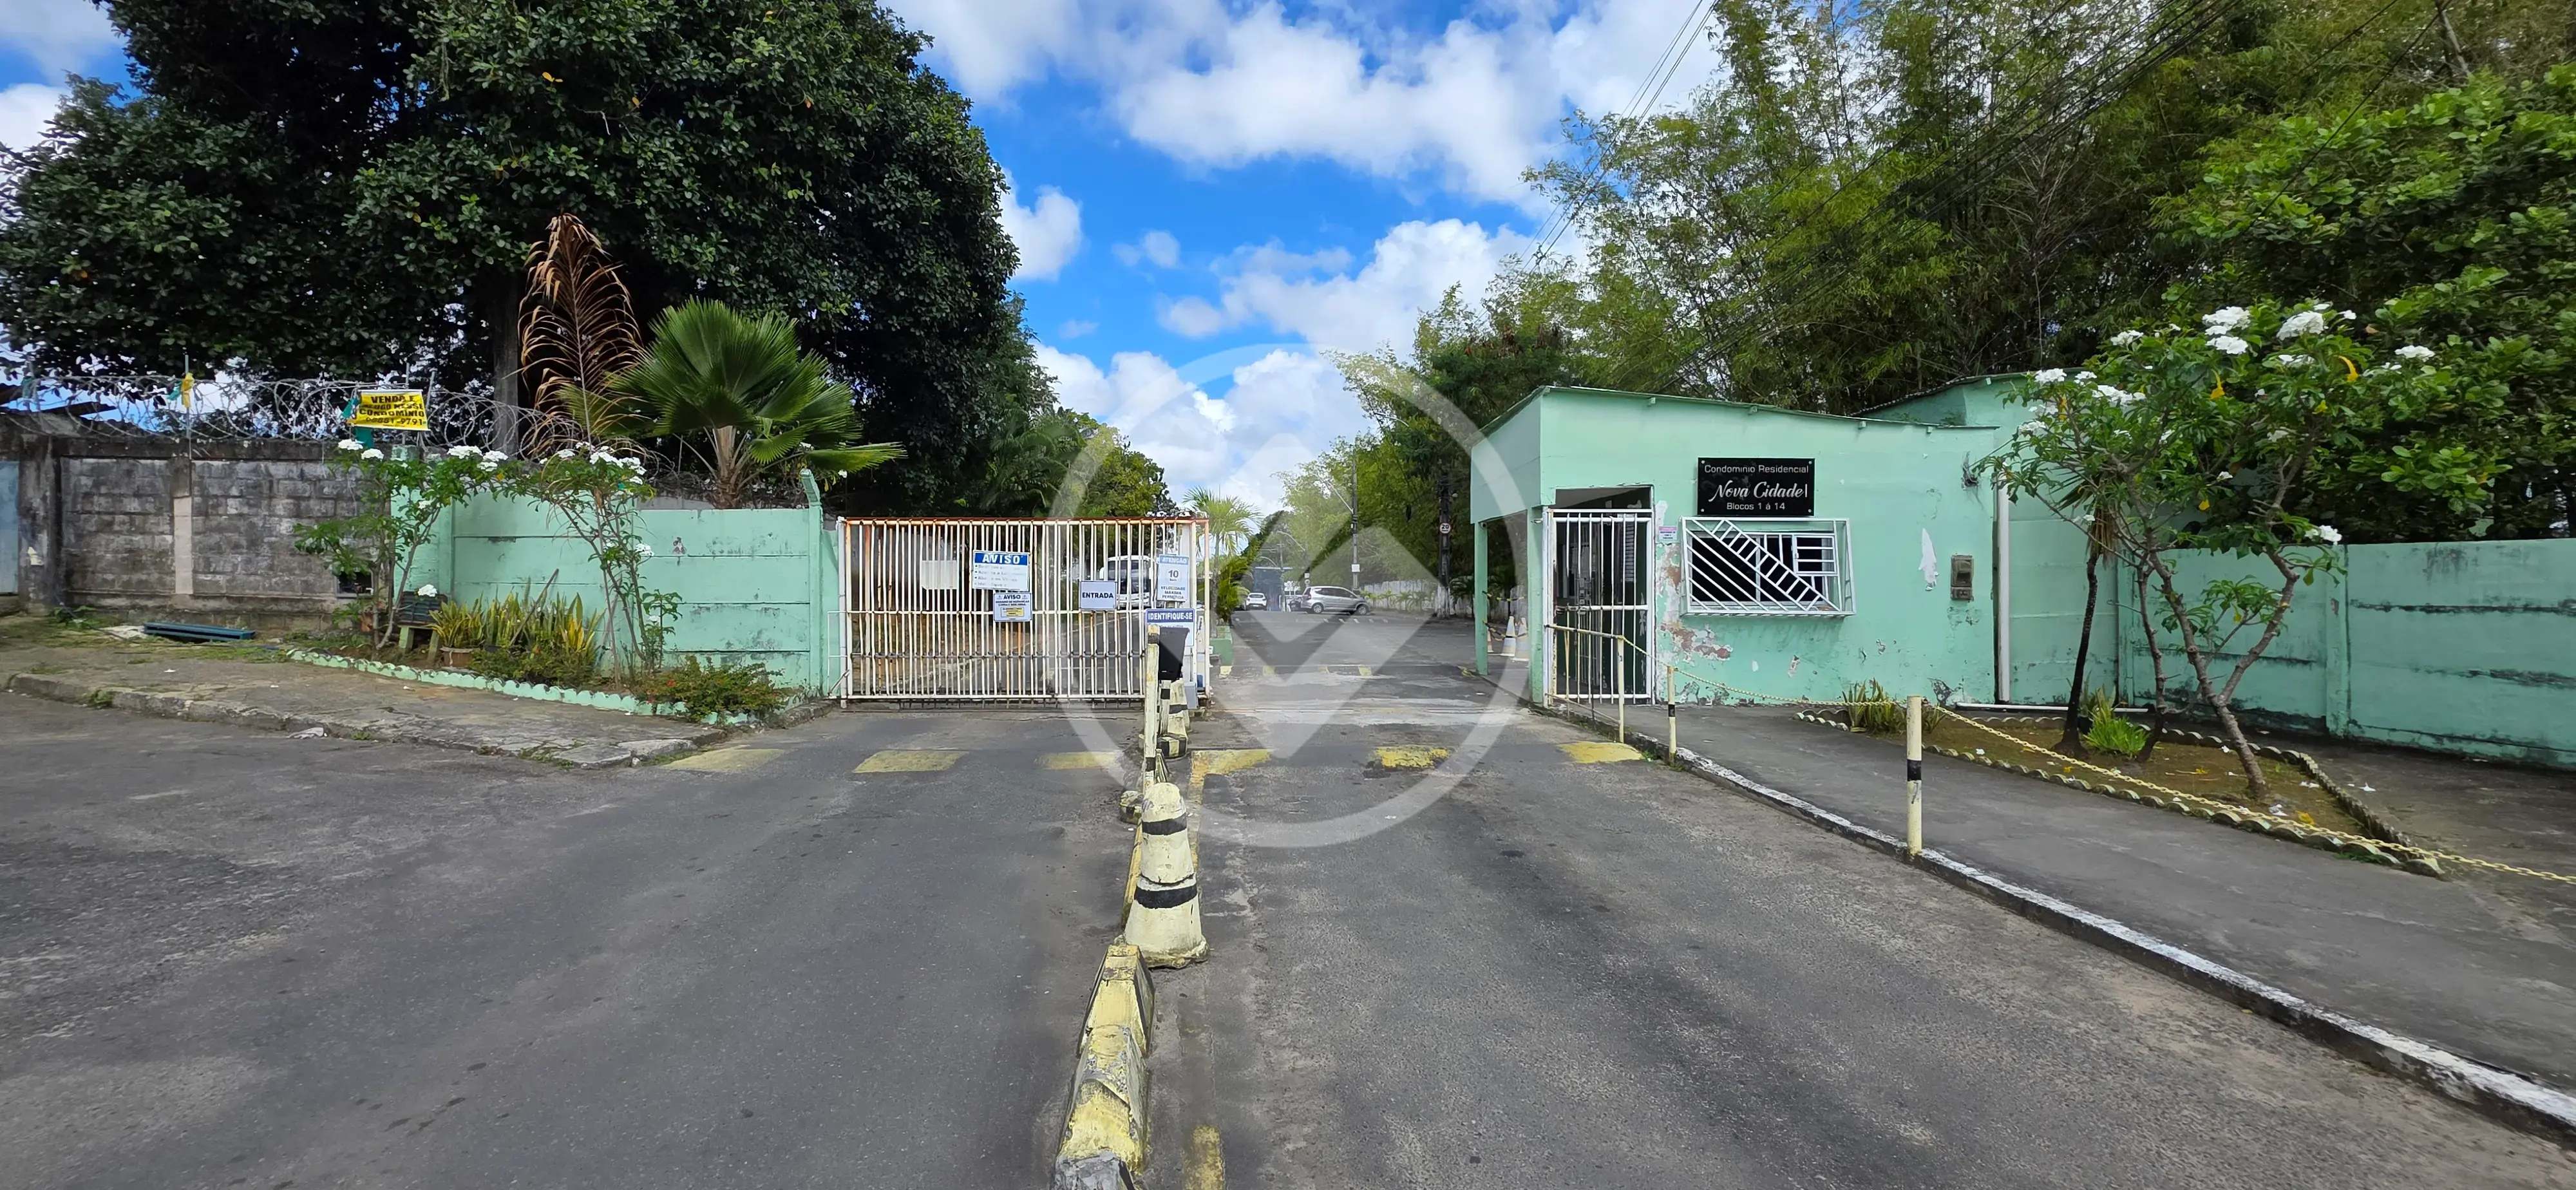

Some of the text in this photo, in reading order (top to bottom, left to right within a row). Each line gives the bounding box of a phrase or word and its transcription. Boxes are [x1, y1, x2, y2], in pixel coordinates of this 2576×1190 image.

[1758, 464, 1809, 473] Residencial
[1708, 480, 1750, 502] Nova
[1753, 481, 1804, 498] Cidade
[982, 554, 1020, 564] AVISO
[1168, 570, 1179, 578] 10
